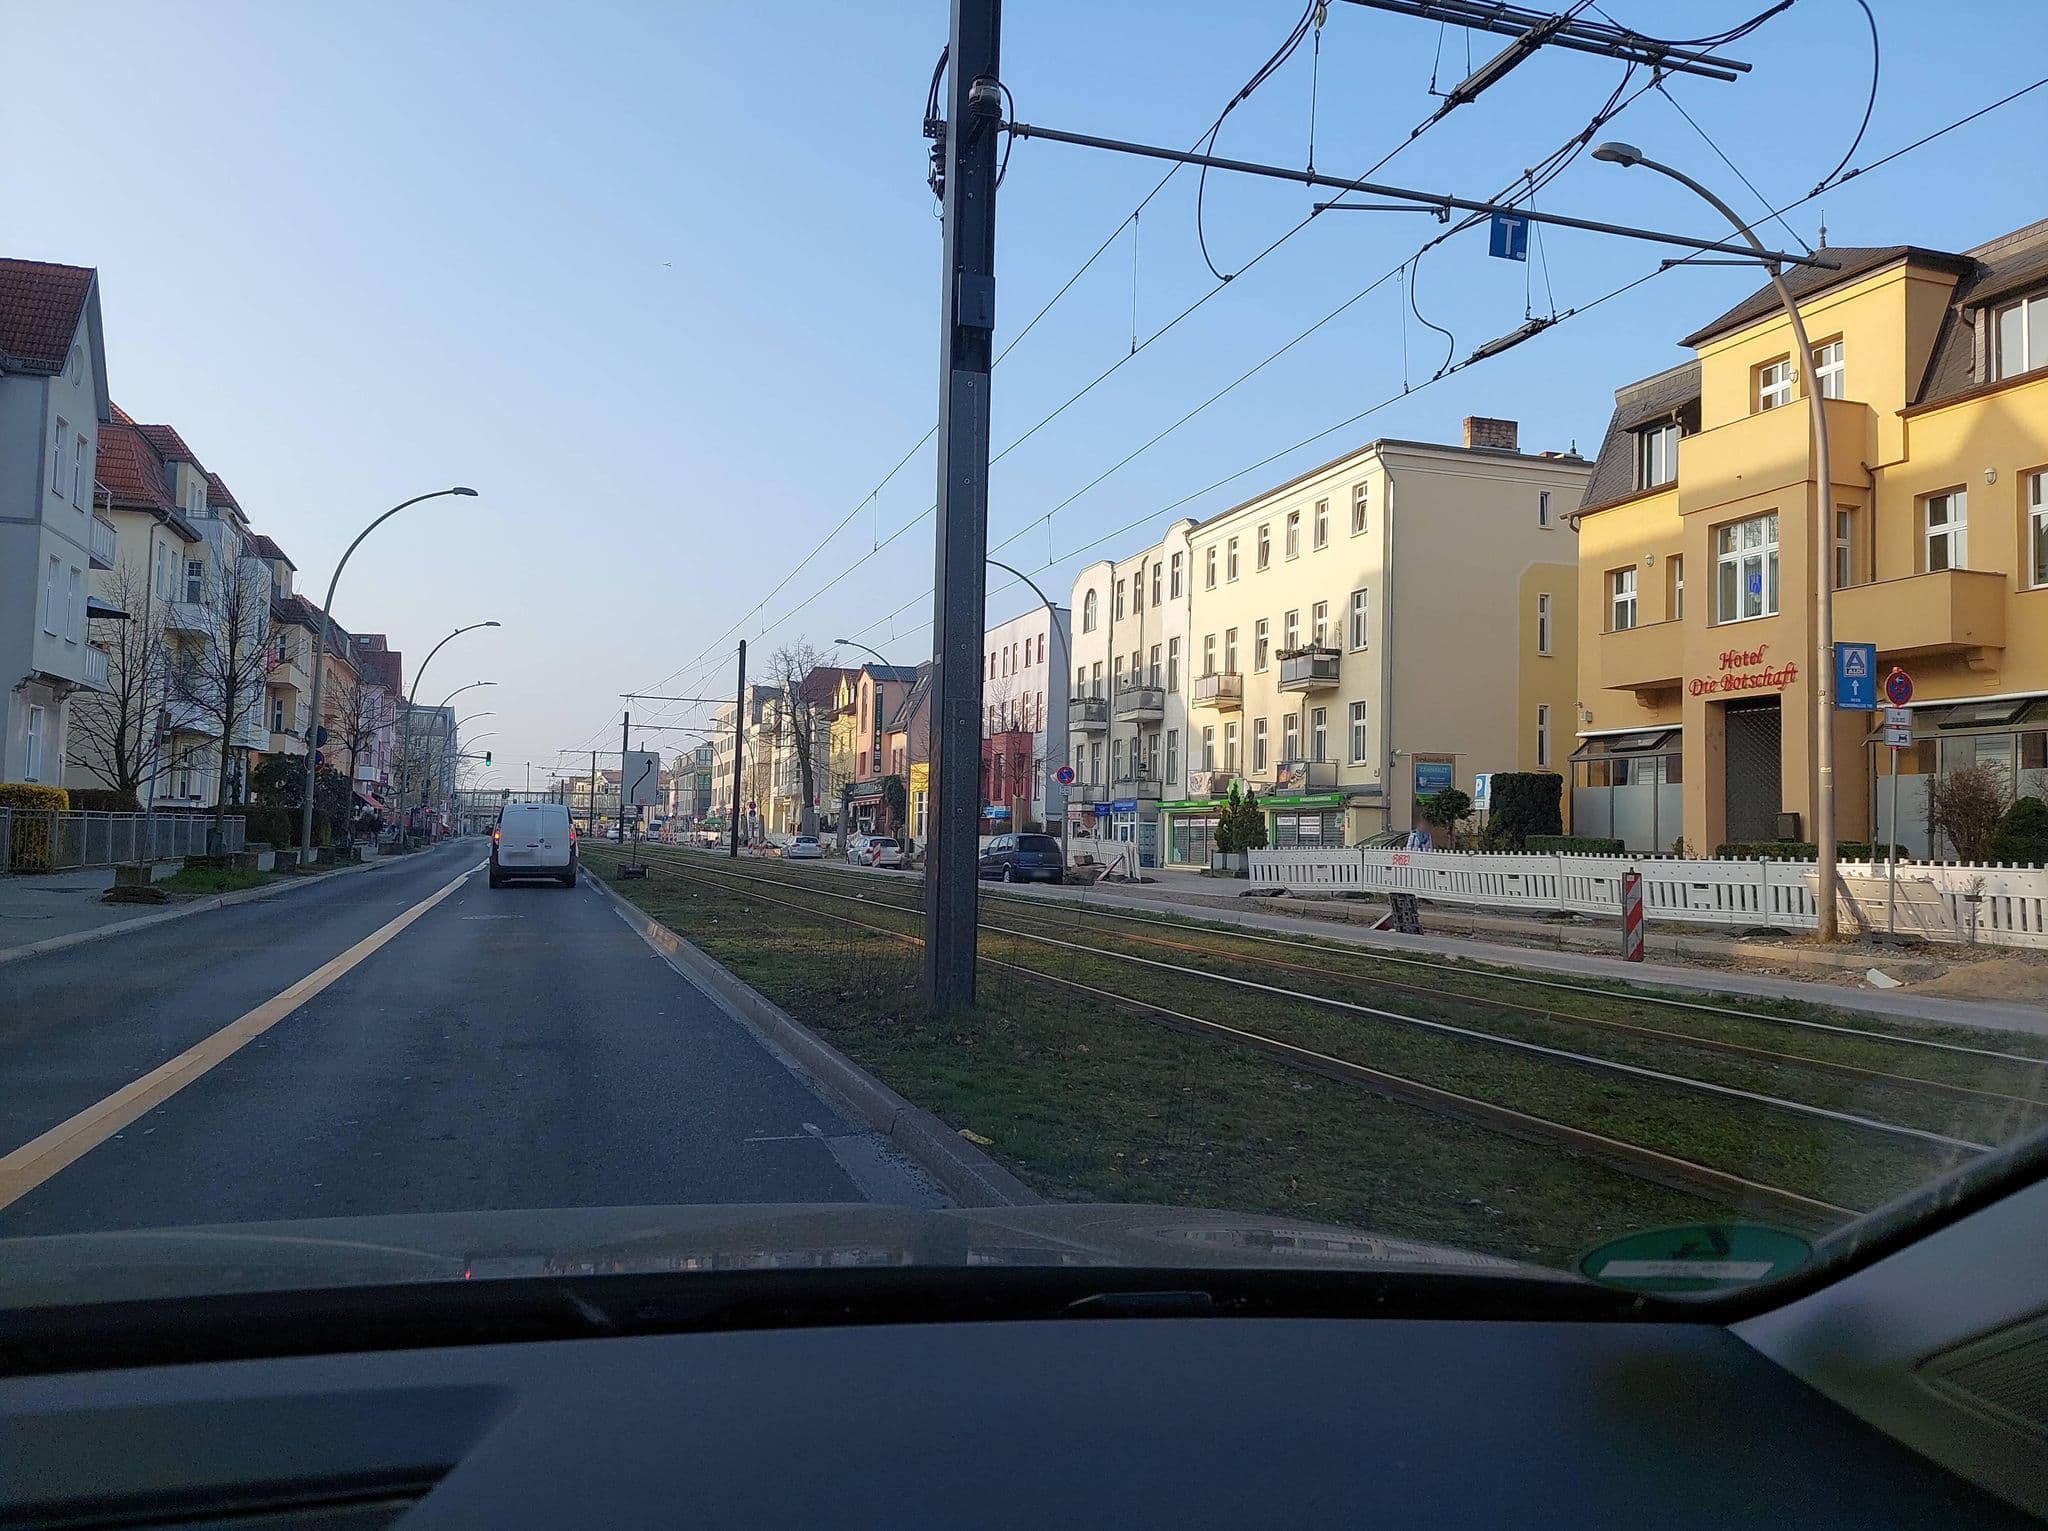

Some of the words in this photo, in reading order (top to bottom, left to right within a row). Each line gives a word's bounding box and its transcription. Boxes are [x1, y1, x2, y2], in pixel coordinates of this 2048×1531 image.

[1499, 217, 1521, 256] T
[1718, 643, 1769, 670] Hotel
[1688, 675, 1717, 697] Die
[1721, 661, 1799, 691] Botschaft
